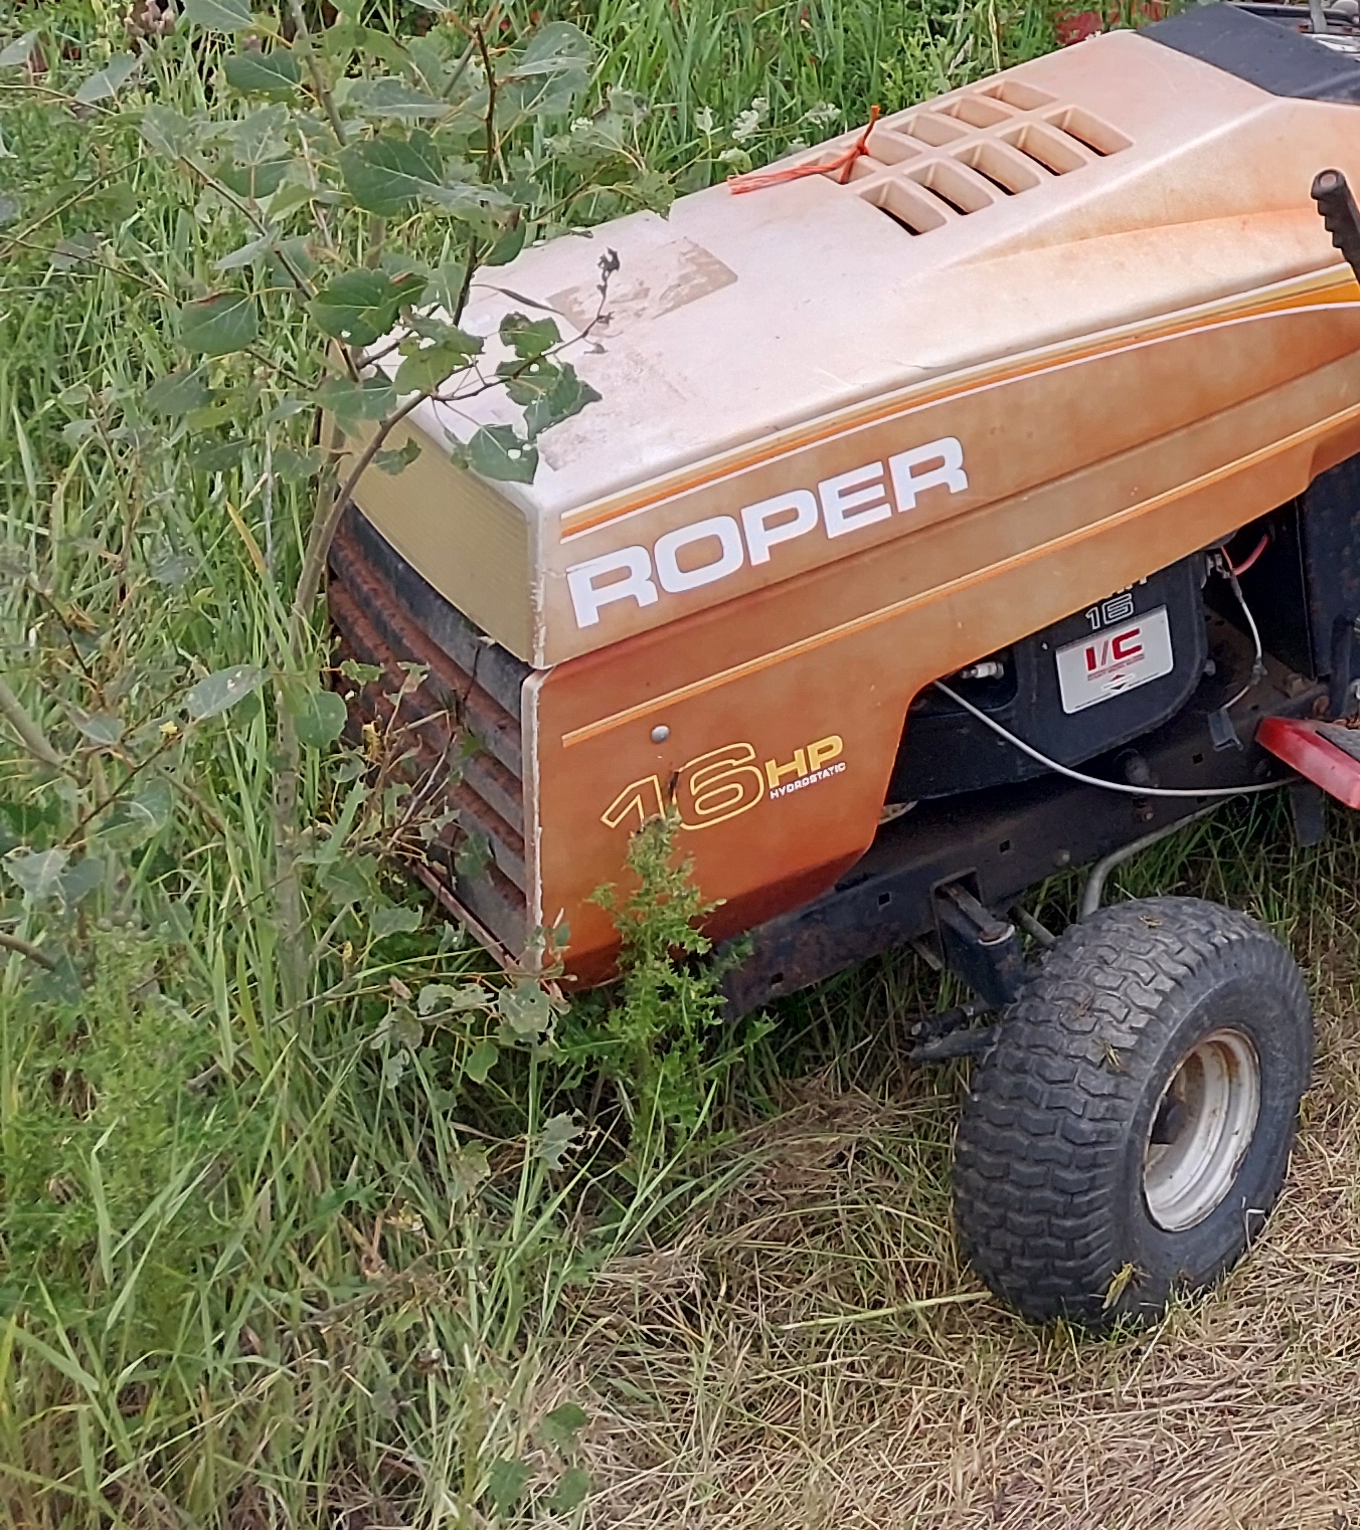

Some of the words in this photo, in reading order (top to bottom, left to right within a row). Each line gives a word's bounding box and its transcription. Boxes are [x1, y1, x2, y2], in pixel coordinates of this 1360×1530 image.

[566, 436, 969, 629] ROPER
[1085, 593, 1134, 630] 16
[1085, 628, 1143, 671] I/C
[601, 742, 764, 830] 16
[765, 735, 843, 789] HP
[769, 761, 847, 800] HYDROSTATIC
